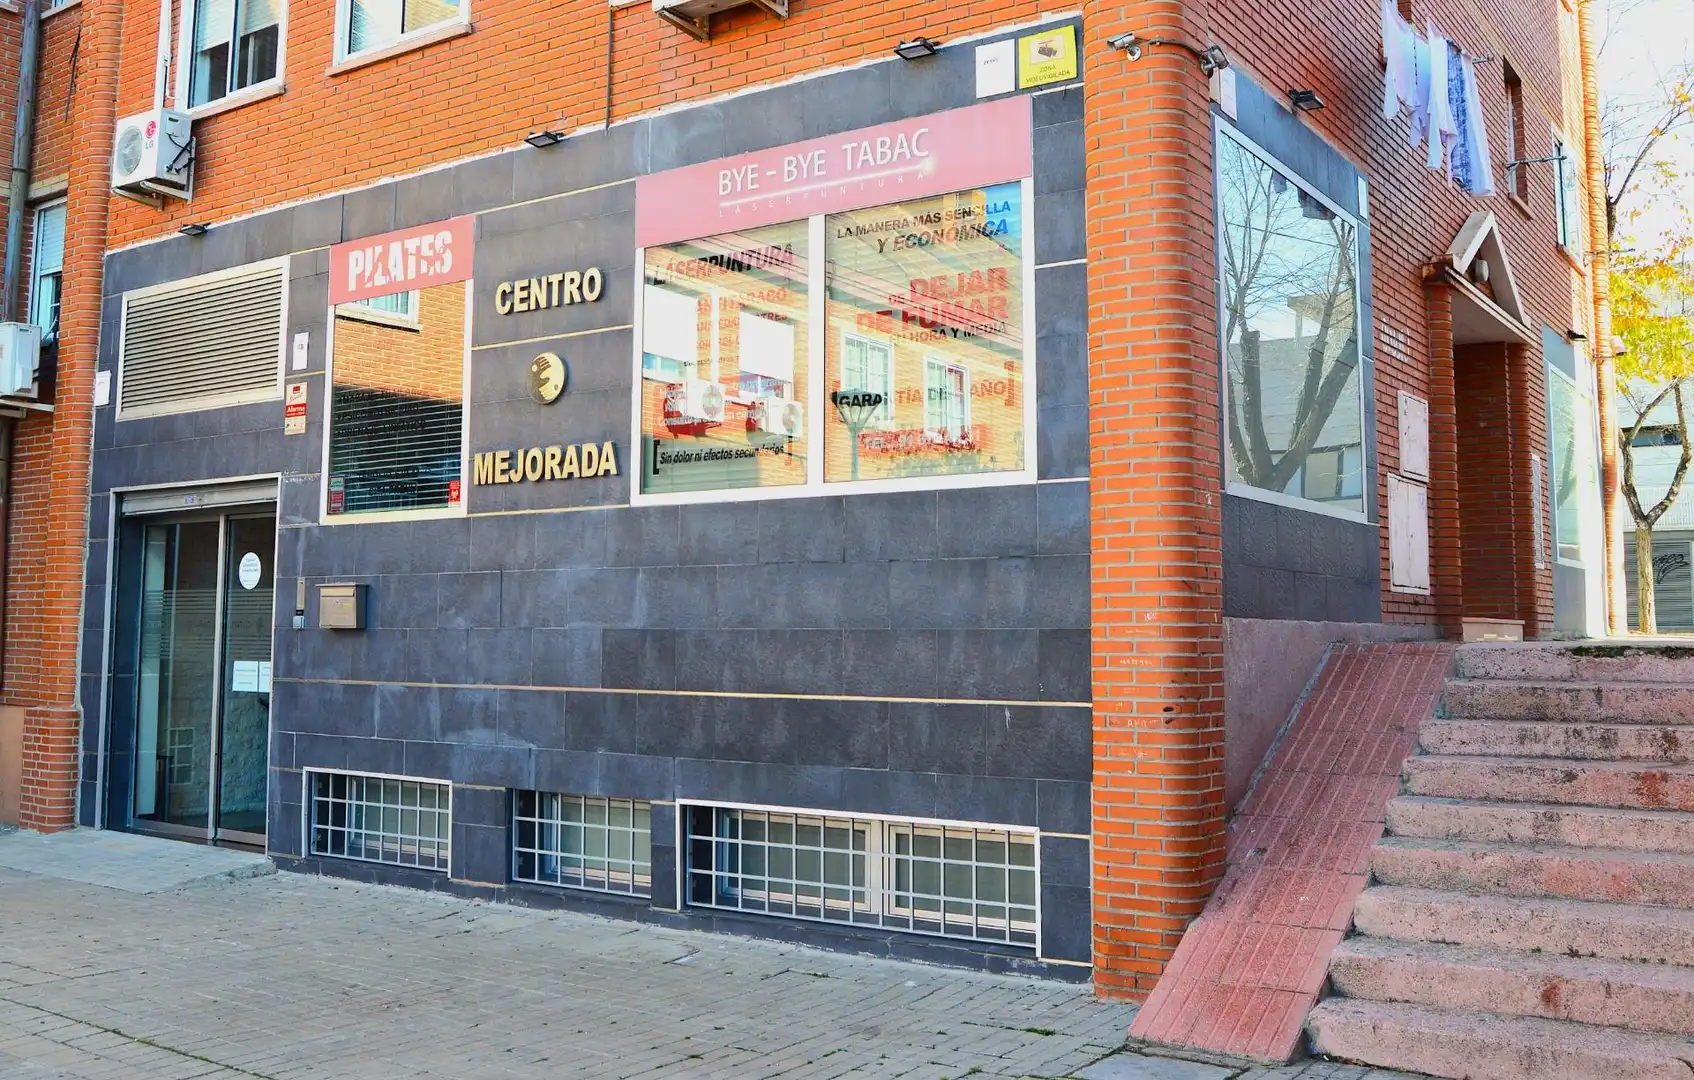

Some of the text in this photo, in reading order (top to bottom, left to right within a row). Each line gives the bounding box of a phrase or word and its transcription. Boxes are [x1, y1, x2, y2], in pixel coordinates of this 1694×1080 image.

[145, 140, 154, 150] LG
[719, 164, 759, 196] BYE
[783, 149, 826, 184] BYE
[841, 127, 929, 173] TABAC
[837, 226, 853, 239] LA
[855, 217, 909, 237] MANERA
[913, 210, 941, 226] MÁS
[348, 230, 453, 292] PILATES
[877, 237, 889, 254] Y
[495, 267, 602, 315] CENTRO
[910, 266, 1009, 300] DEJAR
[902, 296, 1009, 330] FUMAR
[950, 327, 959, 339] Y
[473, 440, 618, 486] MEJORADA
[659, 451, 673, 465] Sin
[673, 449, 694, 464] dolor
[694, 448, 702, 462] ni
[703, 447, 733, 462] efectos
